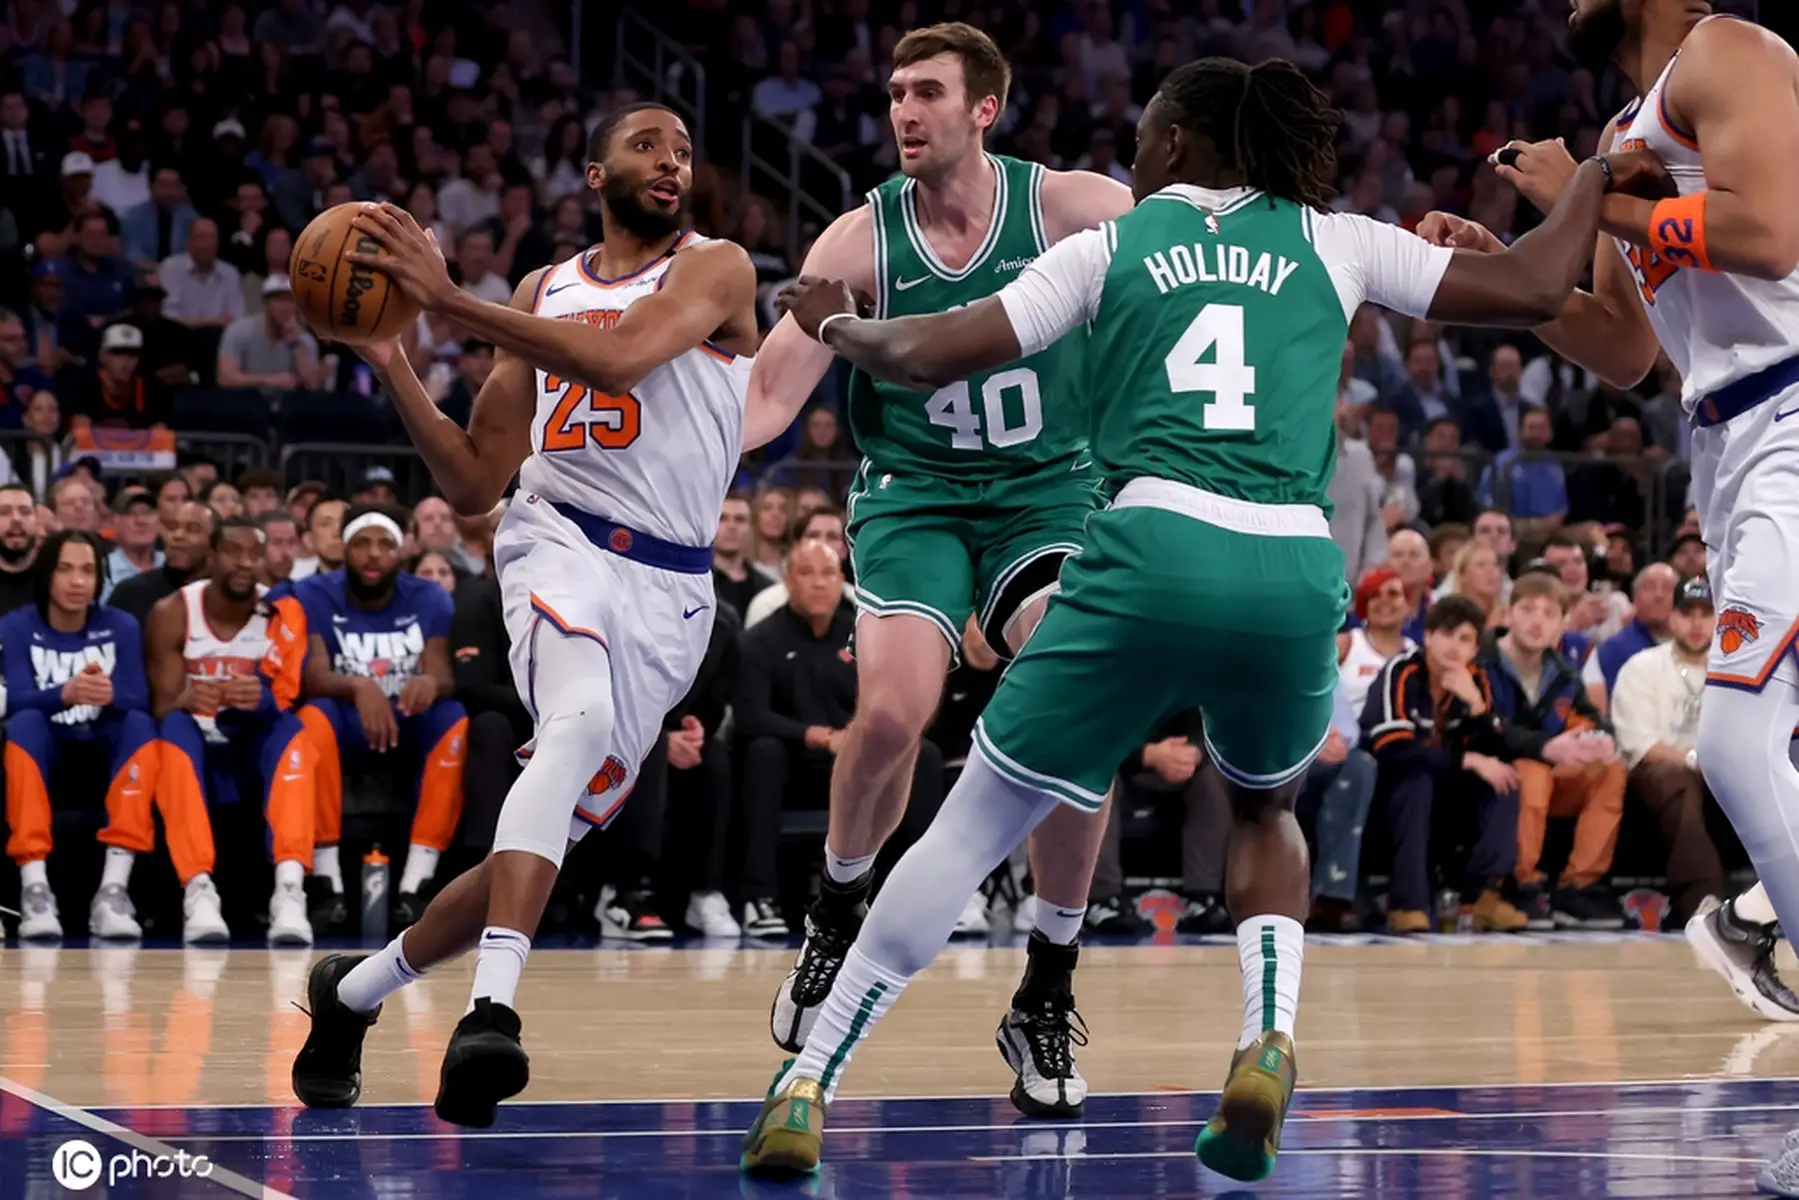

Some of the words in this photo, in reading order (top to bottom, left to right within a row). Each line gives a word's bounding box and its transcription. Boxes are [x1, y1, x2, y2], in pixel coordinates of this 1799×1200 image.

[1143, 242, 1300, 296] HOLIDAY
[1164, 303, 1256, 431] 4
[541, 373, 642, 452] 25
[924, 367, 1043, 450] 40
[30, 641, 116, 684] WIN
[333, 622, 424, 663] WIN
